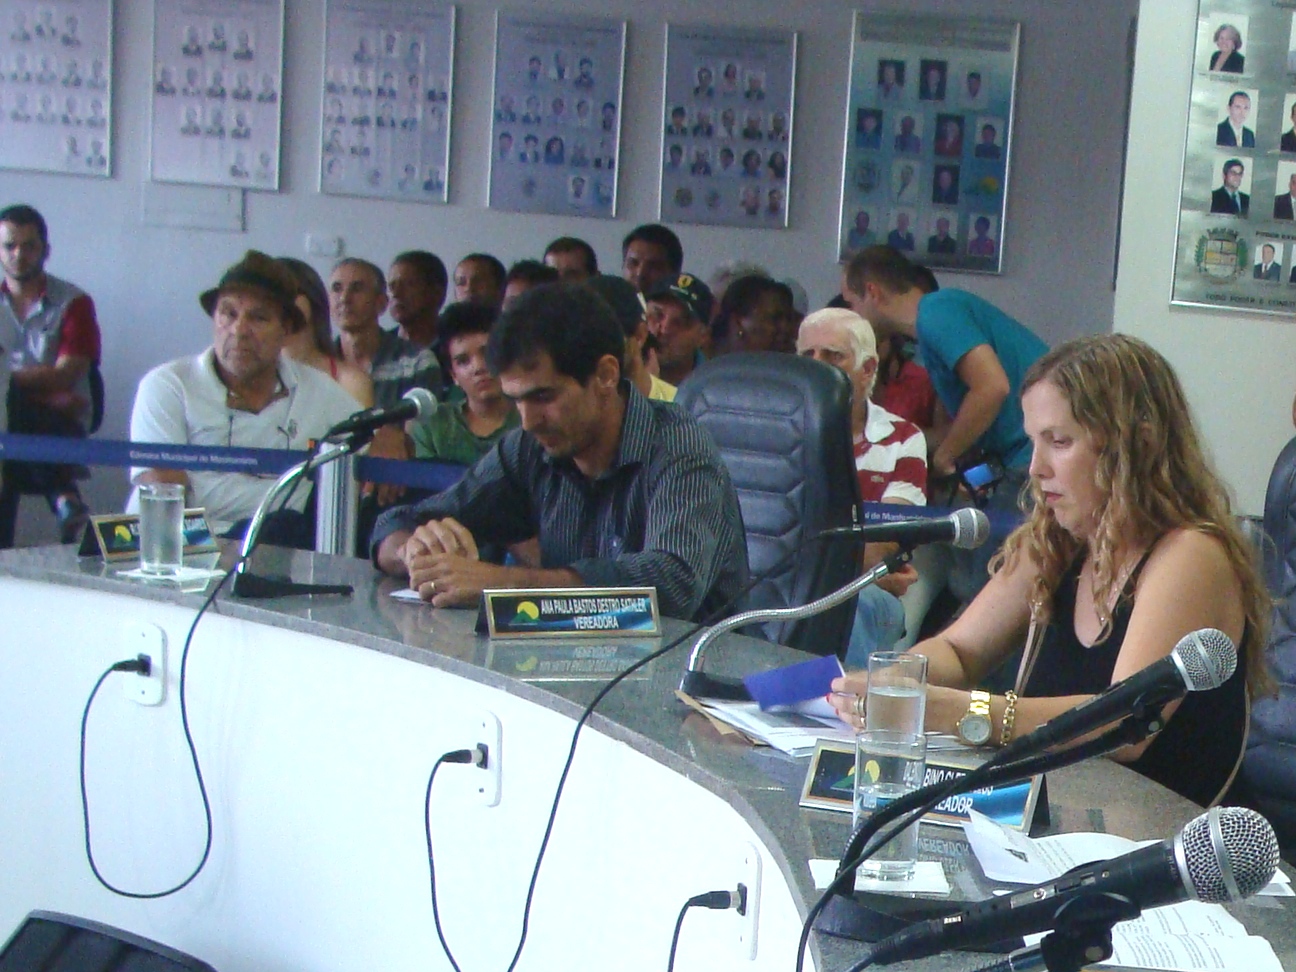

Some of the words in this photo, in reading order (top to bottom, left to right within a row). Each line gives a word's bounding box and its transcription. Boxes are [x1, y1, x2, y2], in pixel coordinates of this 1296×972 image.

[541, 600, 554, 614] ANA
[554, 600, 573, 614] PAULA
[574, 599, 597, 614] BASTOS
[597, 598, 619, 613] DESTRO
[574, 615, 619, 630] VEREADORA
